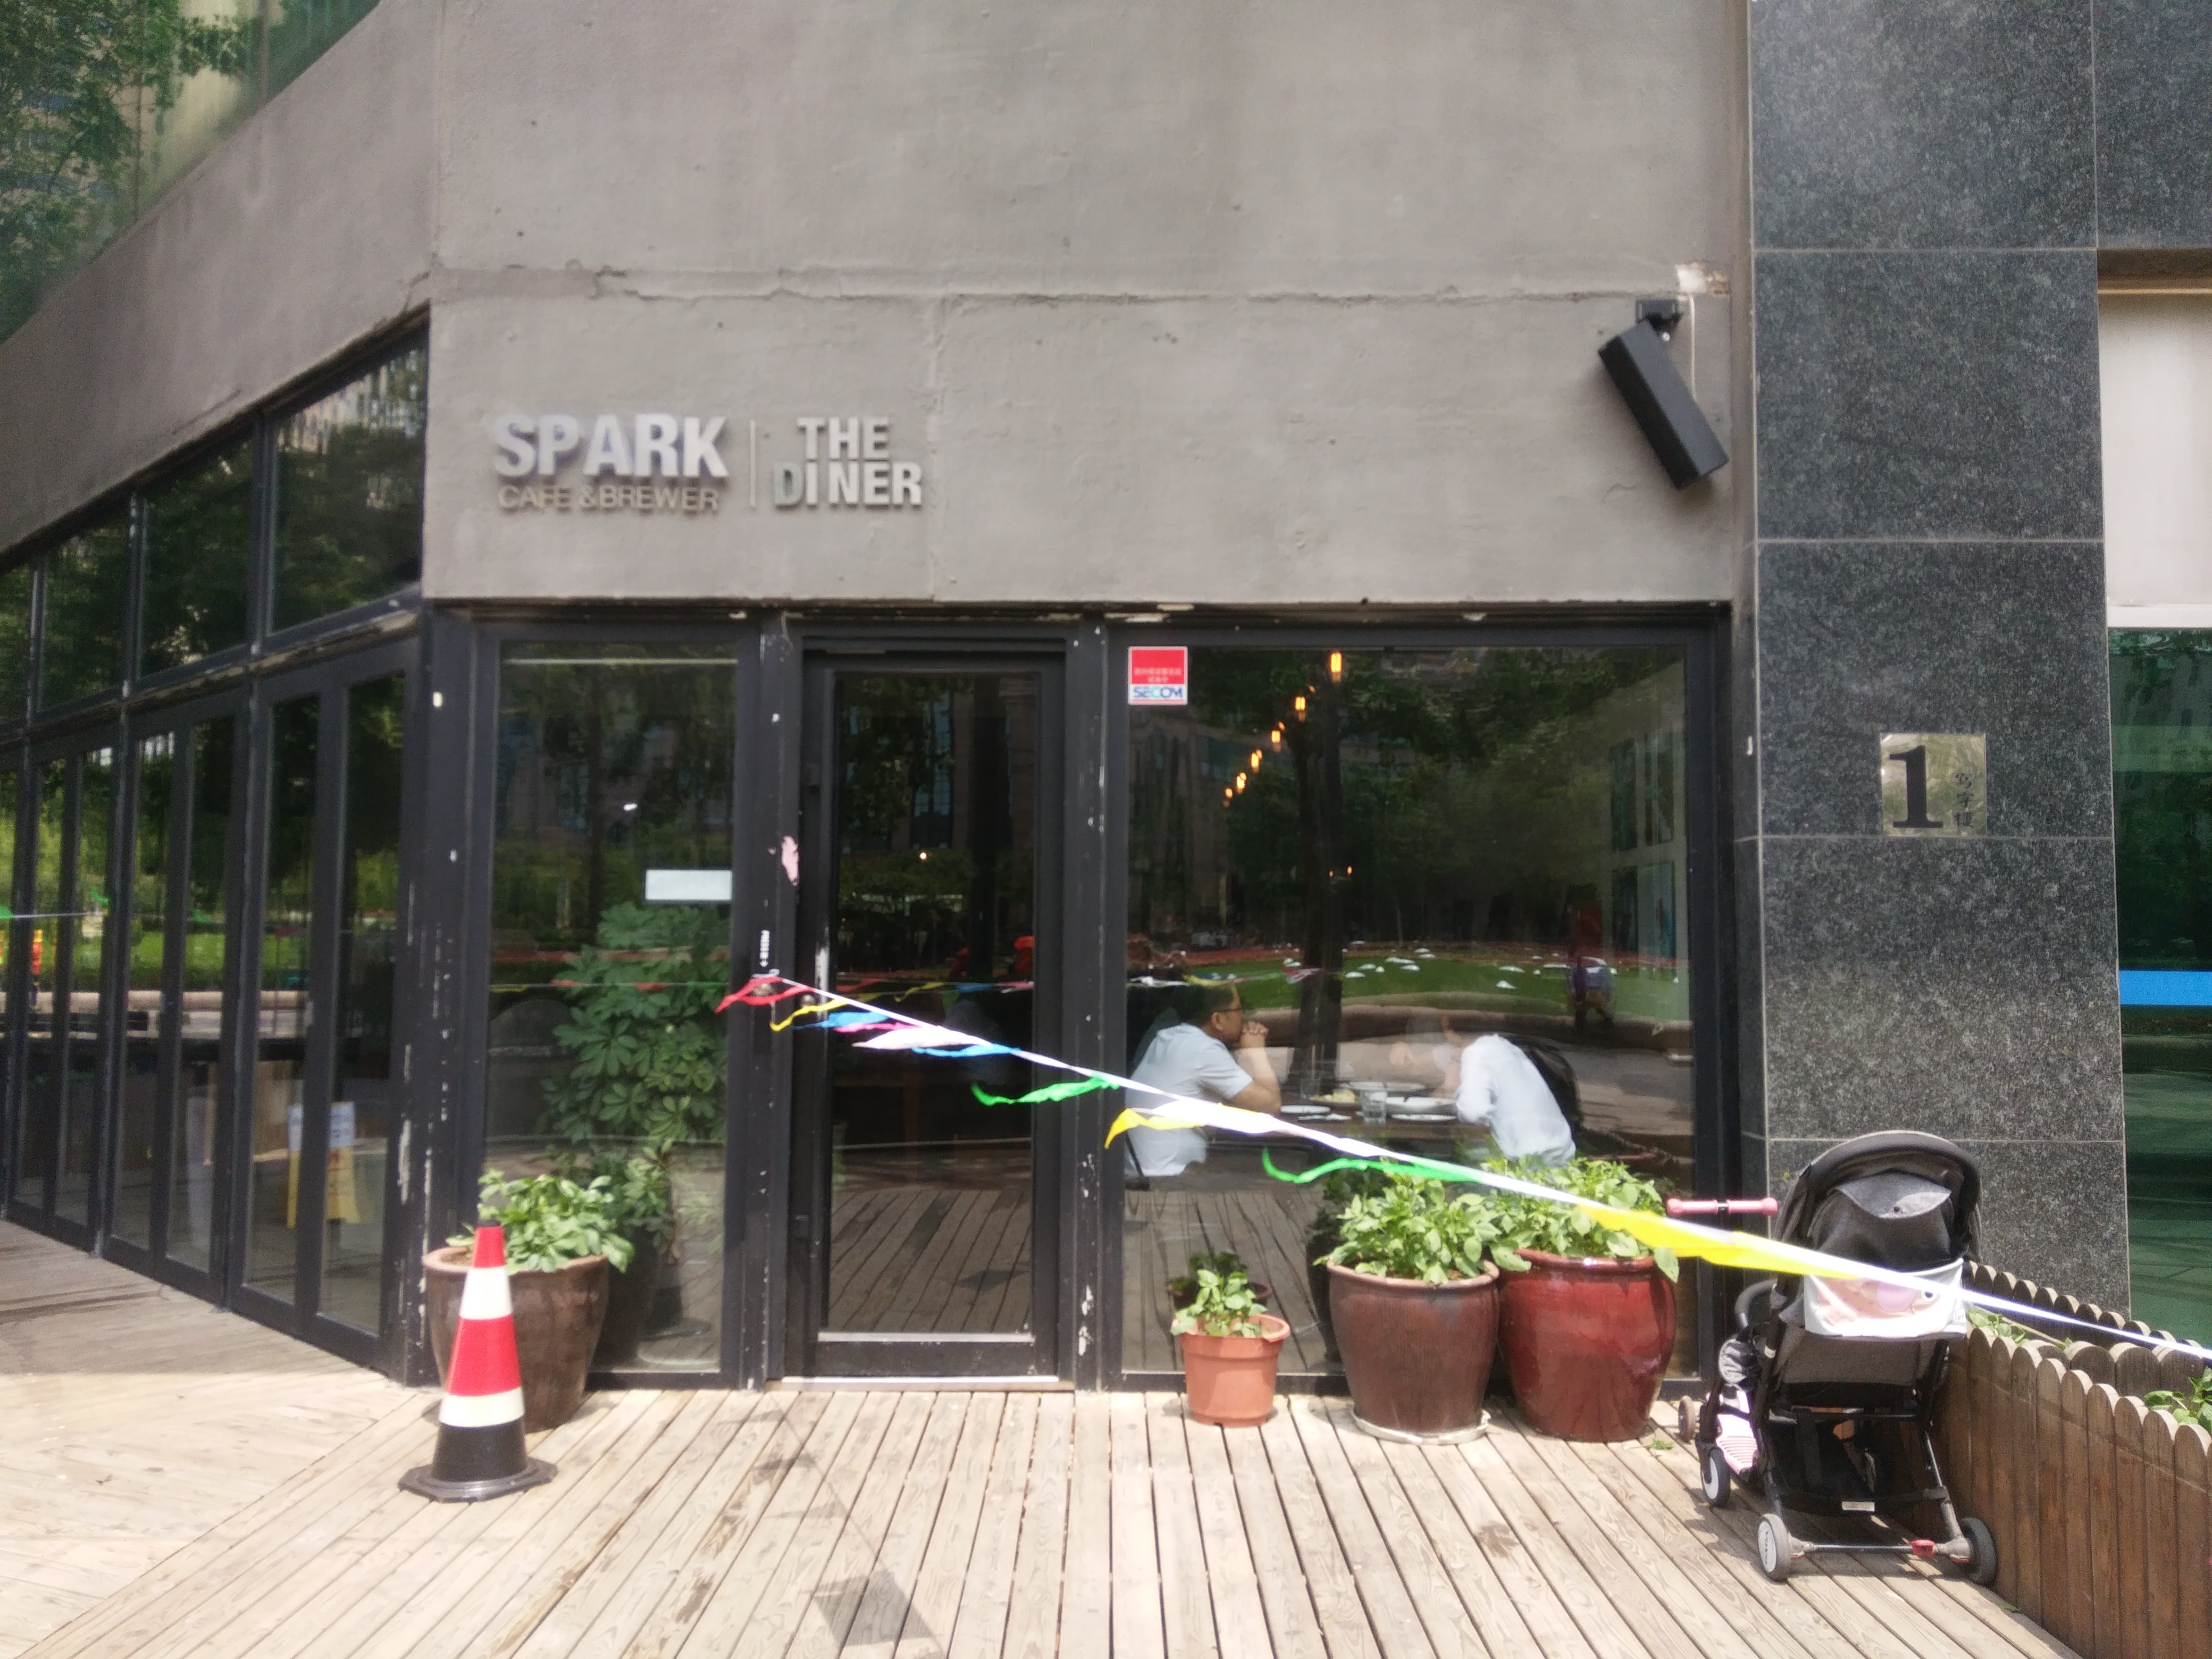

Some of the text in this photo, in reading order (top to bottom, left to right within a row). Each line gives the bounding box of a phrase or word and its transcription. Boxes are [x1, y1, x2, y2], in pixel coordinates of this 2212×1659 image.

[494, 414, 728, 477] SPARK
[797, 416, 890, 459] THE
[498, 484, 573, 509] CAFE
[773, 460, 922, 505] DINER
[1134, 686, 1183, 698] SECOM
[1889, 745, 1944, 828] 1
